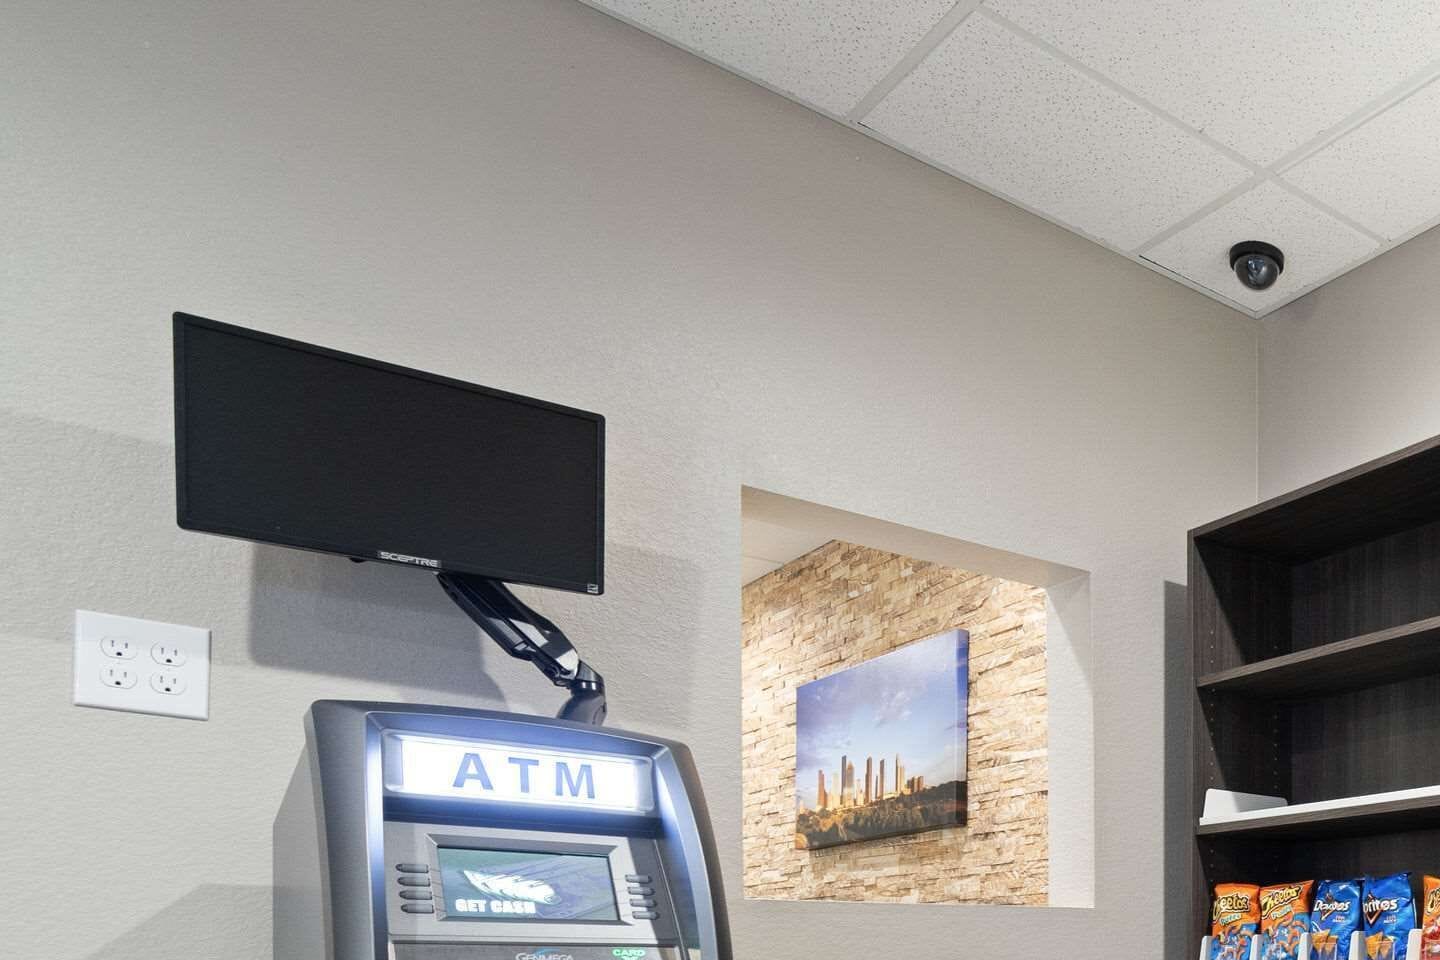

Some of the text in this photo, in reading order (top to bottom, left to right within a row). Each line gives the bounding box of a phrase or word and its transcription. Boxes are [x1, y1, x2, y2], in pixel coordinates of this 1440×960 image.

[380, 551, 439, 568] SCEPTRE
[452, 752, 596, 799] ATM
[455, 899, 536, 914] GET CASH
[1261, 885, 1301, 918] Cheetos
[1314, 899, 1350, 912] Doritos
[1363, 898, 1399, 913] oritos
[612, 949, 646, 957] CARD
